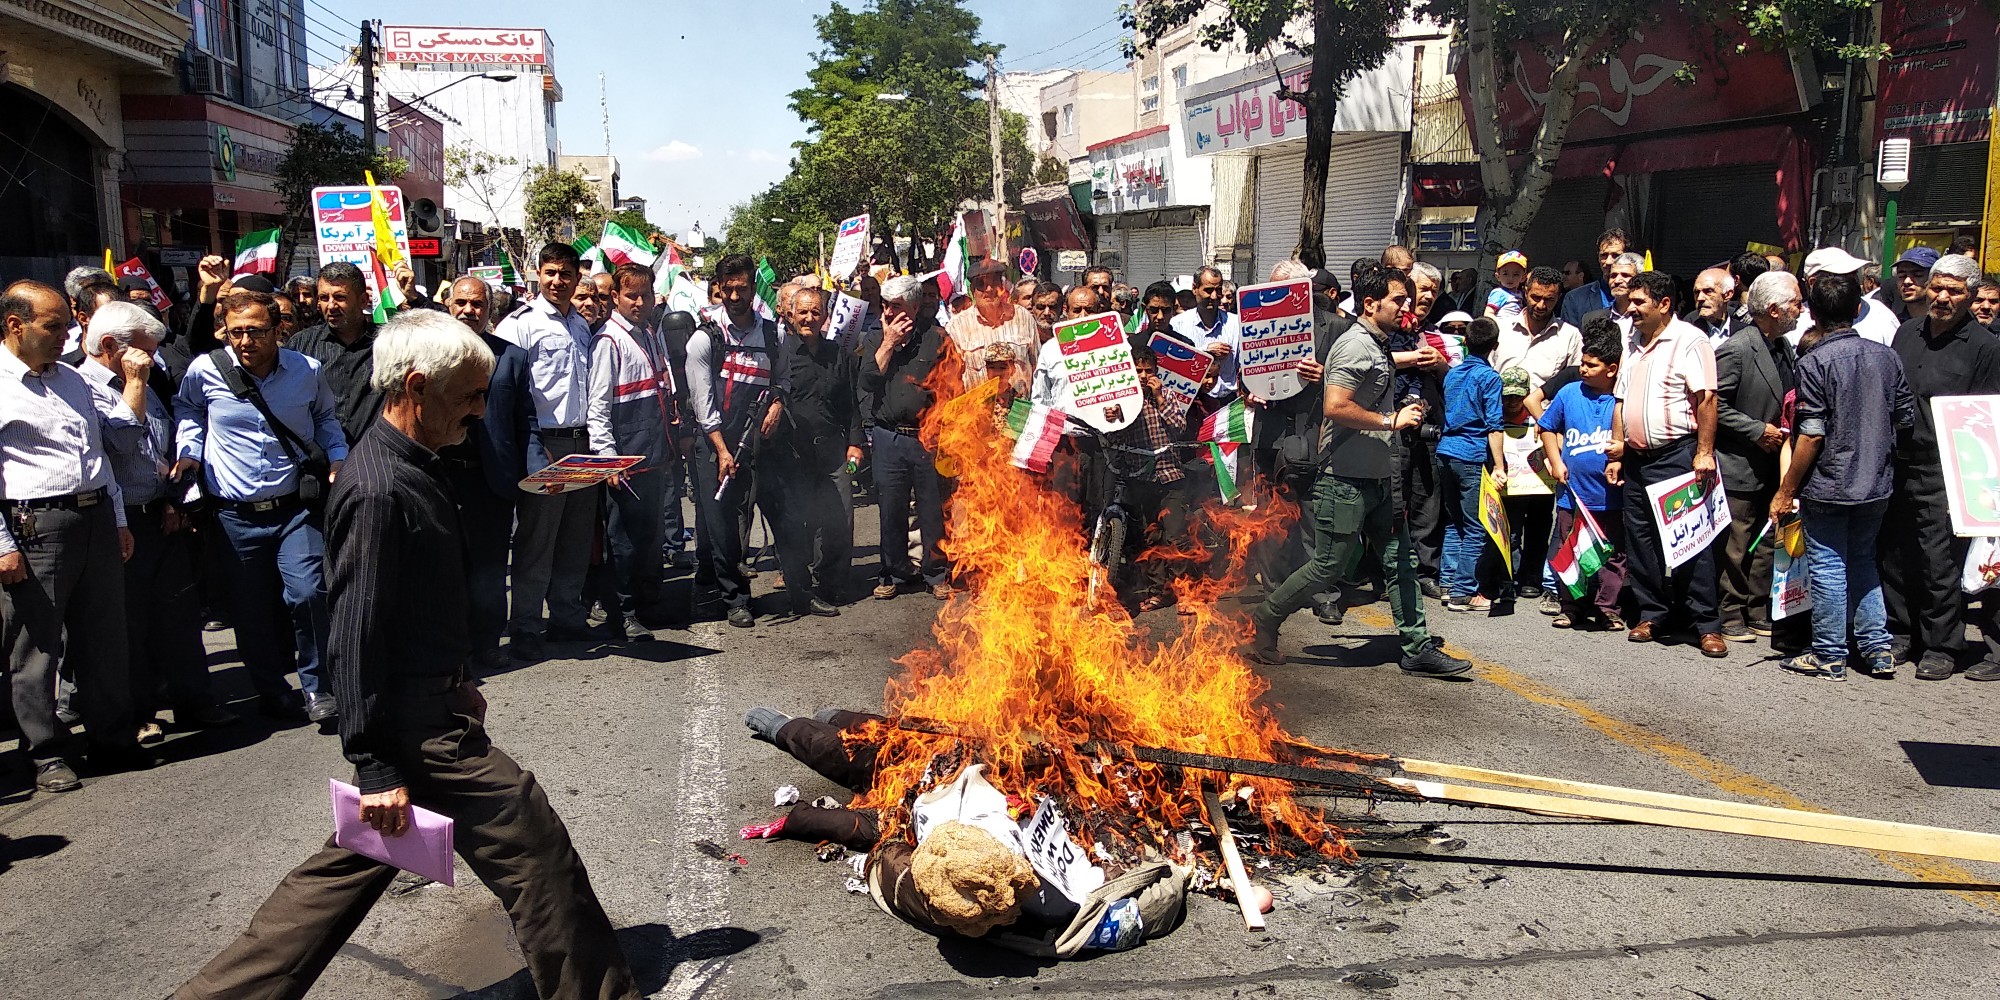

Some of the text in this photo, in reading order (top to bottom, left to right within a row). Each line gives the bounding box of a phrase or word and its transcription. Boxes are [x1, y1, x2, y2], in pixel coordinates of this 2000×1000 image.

[417, 33, 534, 50] بانک مسکن
[395, 52, 535, 63] BANK MASKAN
[1216, 85, 1263, 148] خواب
[320, 223, 361, 242] آمریکا
[324, 244, 353, 252] DOWN
[848, 304, 862, 333] ISRAEL
[1241, 318, 1312, 339] مرگ بر آمریکا
[1244, 340, 1268, 350] DOWN
[1269, 337, 1288, 347] WITH
[1064, 349, 1129, 371] مرگ بر آمریکا
[1243, 344, 1313, 366] مرگ بر اسرائیل
[1070, 370, 1092, 382] DOWN
[1092, 366, 1111, 377] WITH
[1245, 361, 1299, 375] DOWN WITH ISR
[1073, 373, 1135, 397] مرگ بر اسرائیل
[1164, 379, 1197, 395] مرگ بر
[1076, 388, 1137, 408] DOWN WITH ISRAEL
[1671, 513, 1704, 548] اسرائیل
[1673, 541, 1696, 560] DOWN
[1696, 527, 1712, 545] WITH
